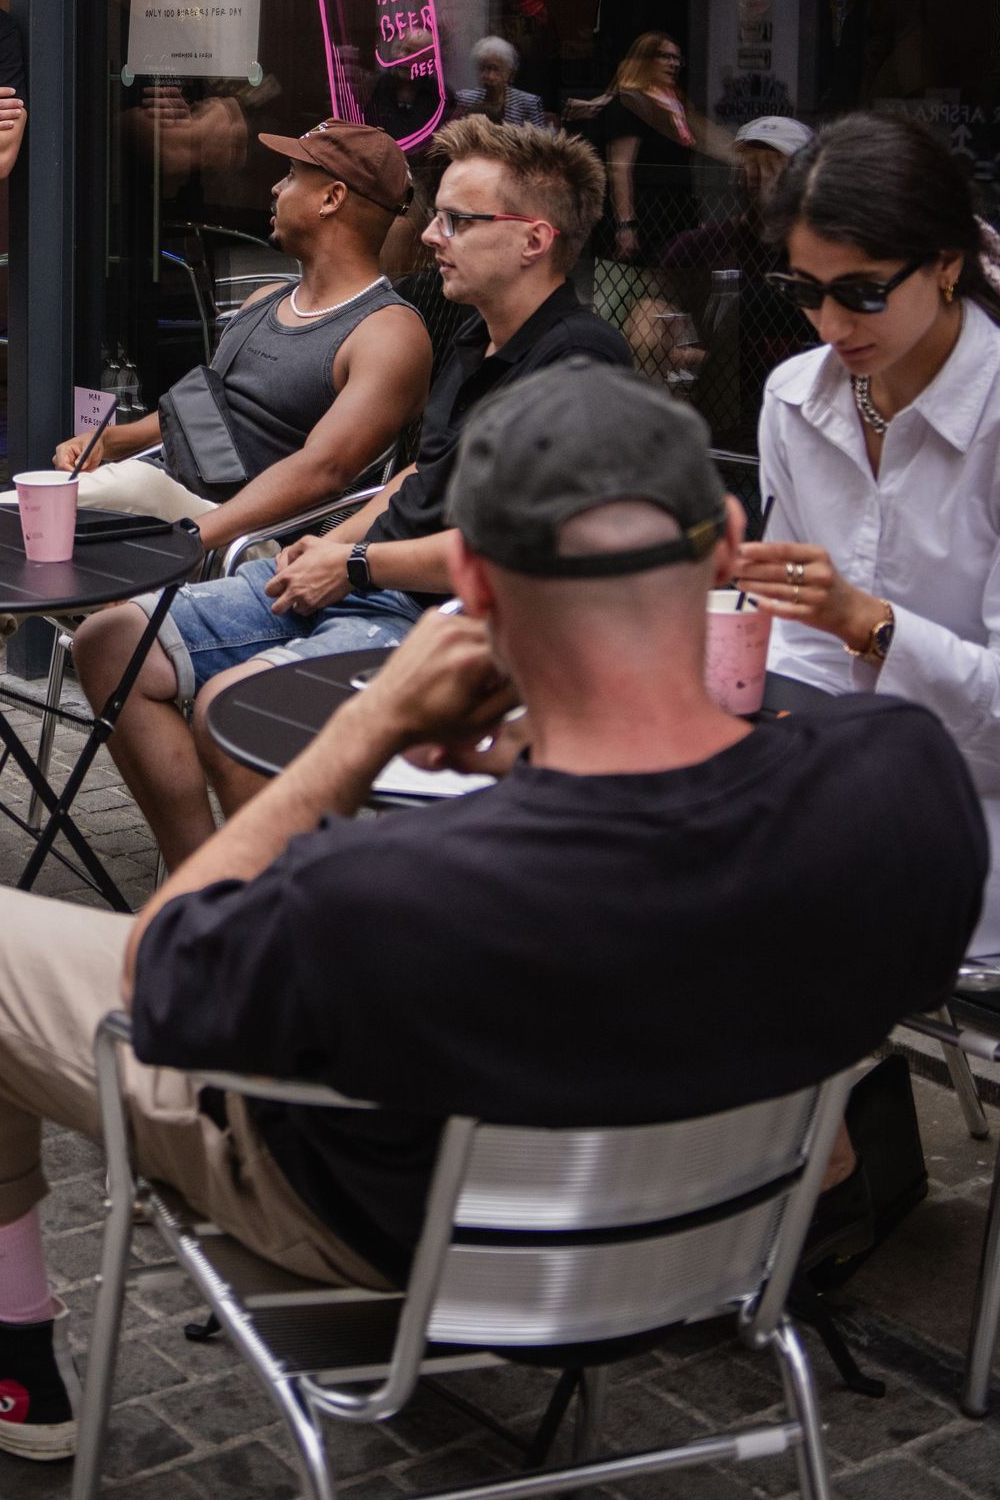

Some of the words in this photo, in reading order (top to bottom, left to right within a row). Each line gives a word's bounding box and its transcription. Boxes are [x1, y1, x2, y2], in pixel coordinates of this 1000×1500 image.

[145, 8, 162, 18] ONLY
[163, 8, 175, 18] 100
[211, 7, 227, 17] PER
[229, 7, 242, 16] DAY
[380, 5, 434, 43] BEER
